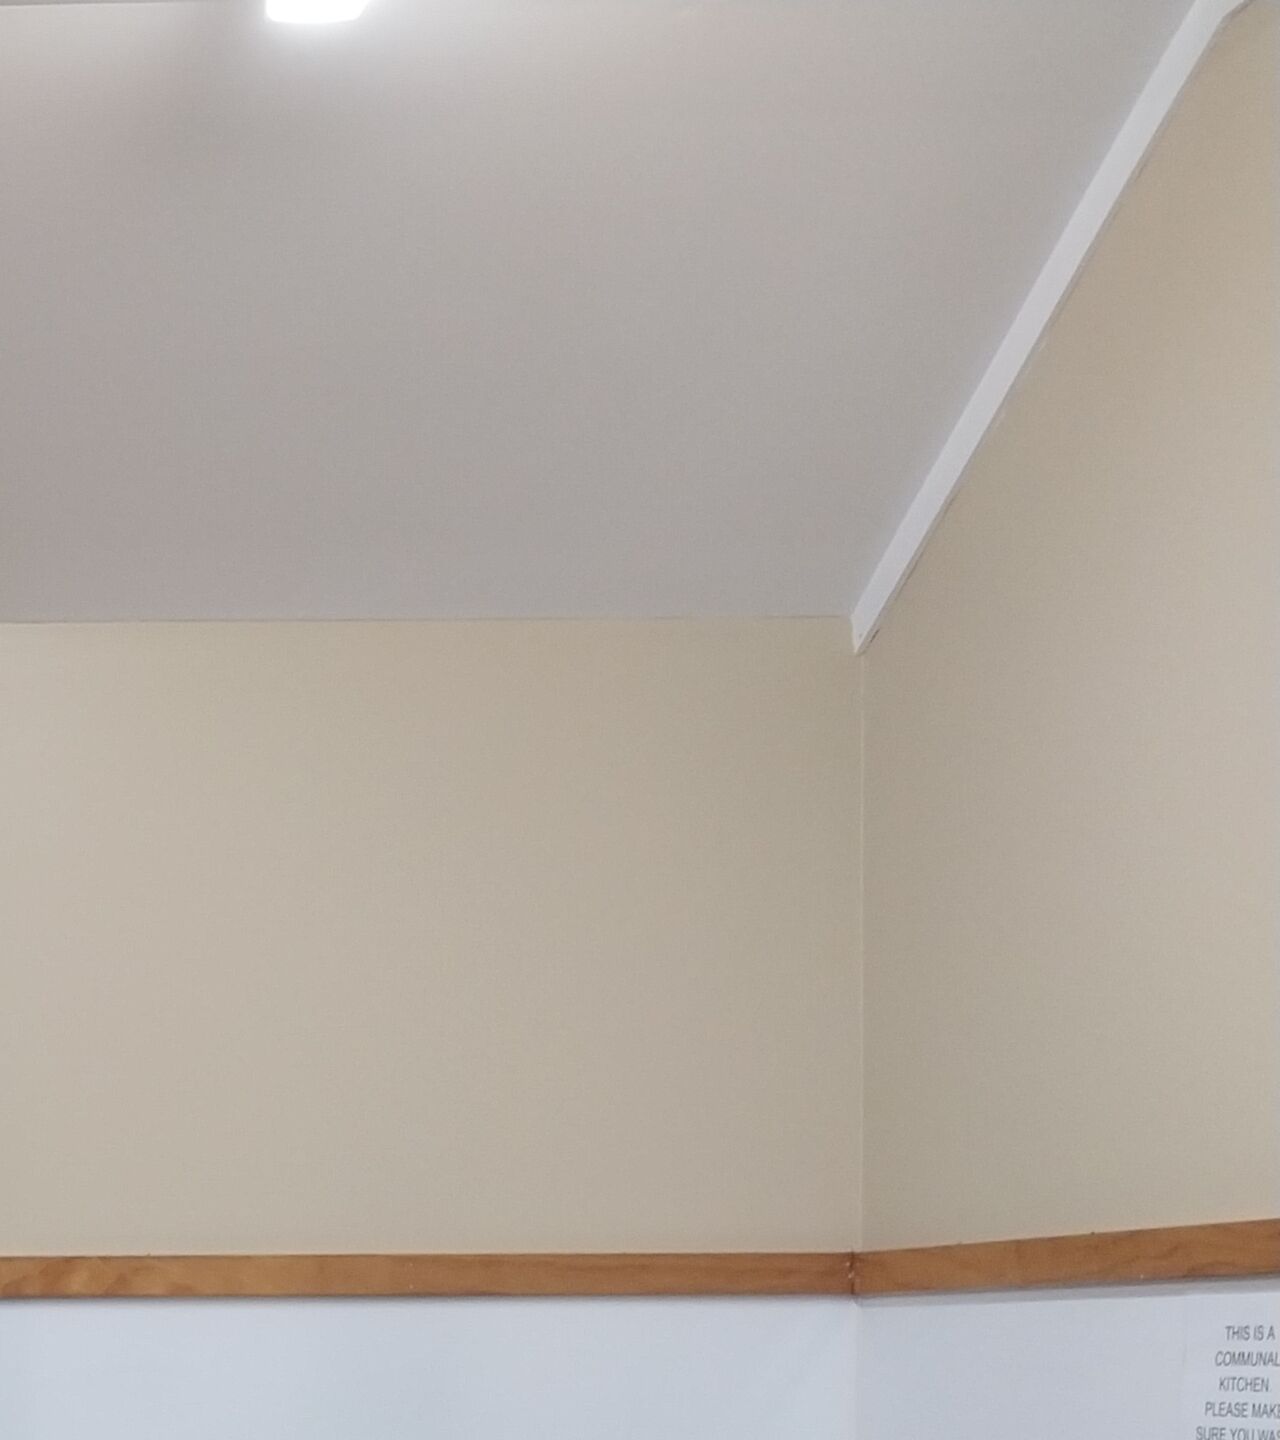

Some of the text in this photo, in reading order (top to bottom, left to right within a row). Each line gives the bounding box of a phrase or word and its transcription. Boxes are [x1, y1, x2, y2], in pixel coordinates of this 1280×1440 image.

[1225, 1325, 1276, 1341] THIS IS A
[1215, 1351, 1280, 1367] COMMUNAL
[1205, 1401, 1248, 1418] PLEASE
